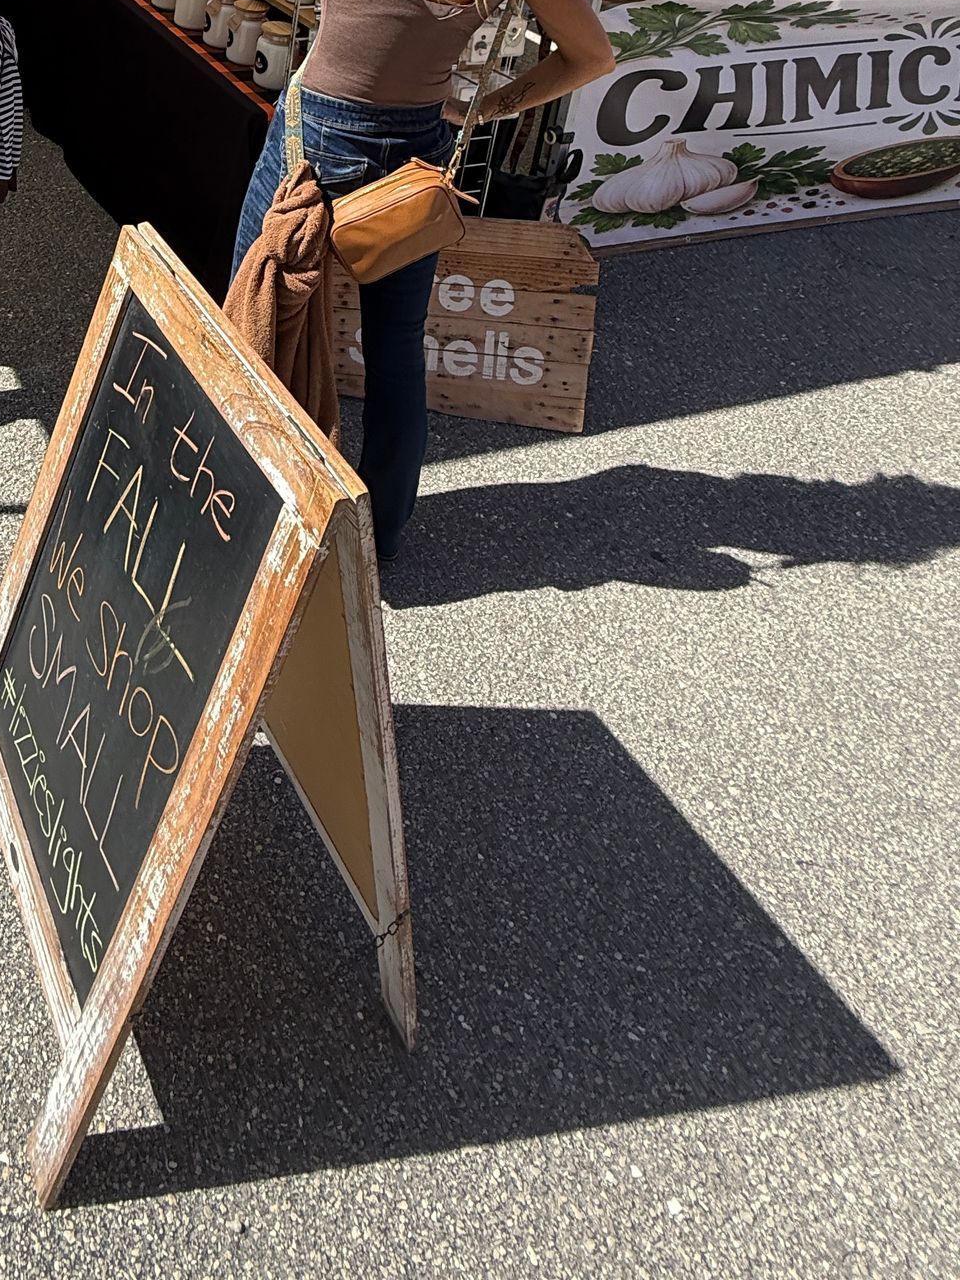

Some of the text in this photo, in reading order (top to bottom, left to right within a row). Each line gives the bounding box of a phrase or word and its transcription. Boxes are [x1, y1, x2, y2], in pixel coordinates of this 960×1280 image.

[596, 45, 960, 147] CHIMIC
[113, 331, 235, 541] In the
[49, 489, 85, 622] We
[86, 428, 194, 682] FALL
[1, 666, 104, 974] #lizzieslights
[28, 593, 120, 892] SMALL
